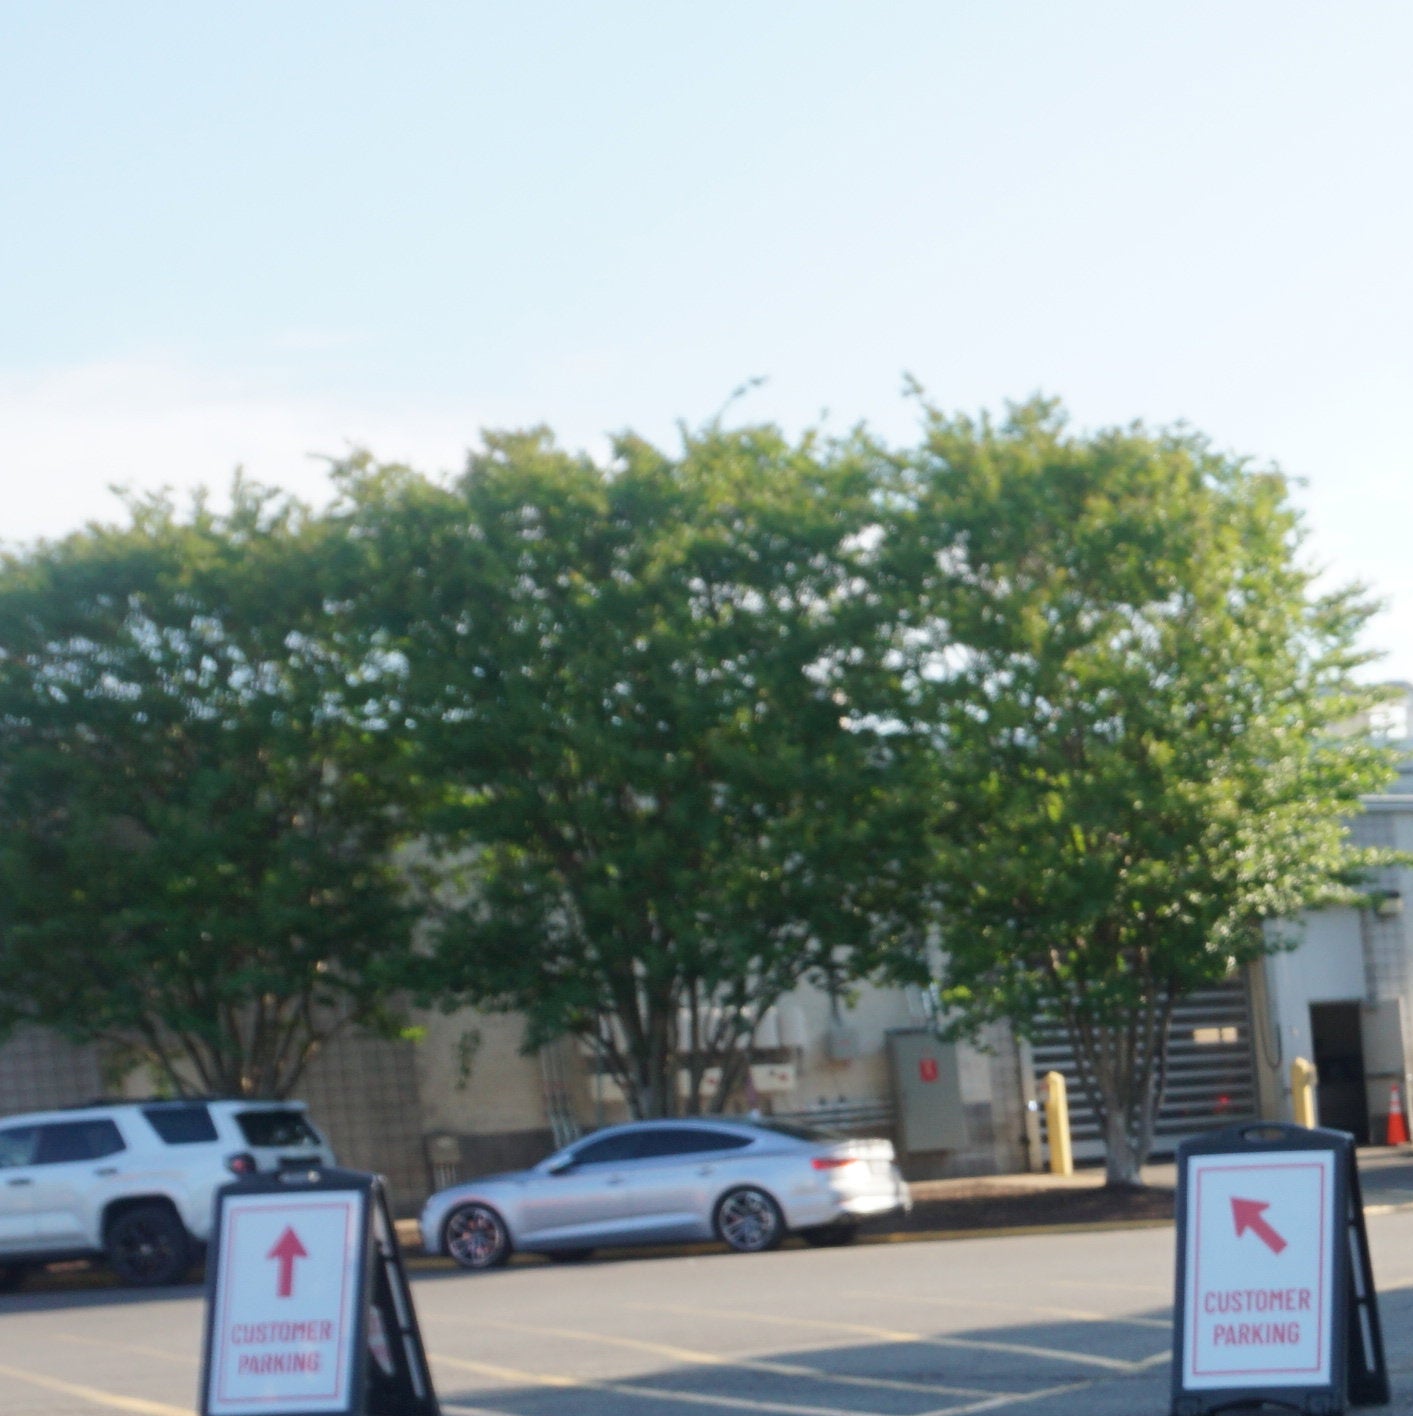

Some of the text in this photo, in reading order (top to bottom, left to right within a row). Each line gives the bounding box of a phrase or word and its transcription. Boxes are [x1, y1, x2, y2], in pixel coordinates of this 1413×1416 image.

[1204, 1288, 1310, 1313] CUSTOMER
[231, 1320, 333, 1344] CUSTOMER
[1213, 1321, 1300, 1345] PARKING
[239, 1351, 321, 1375] PARKING
